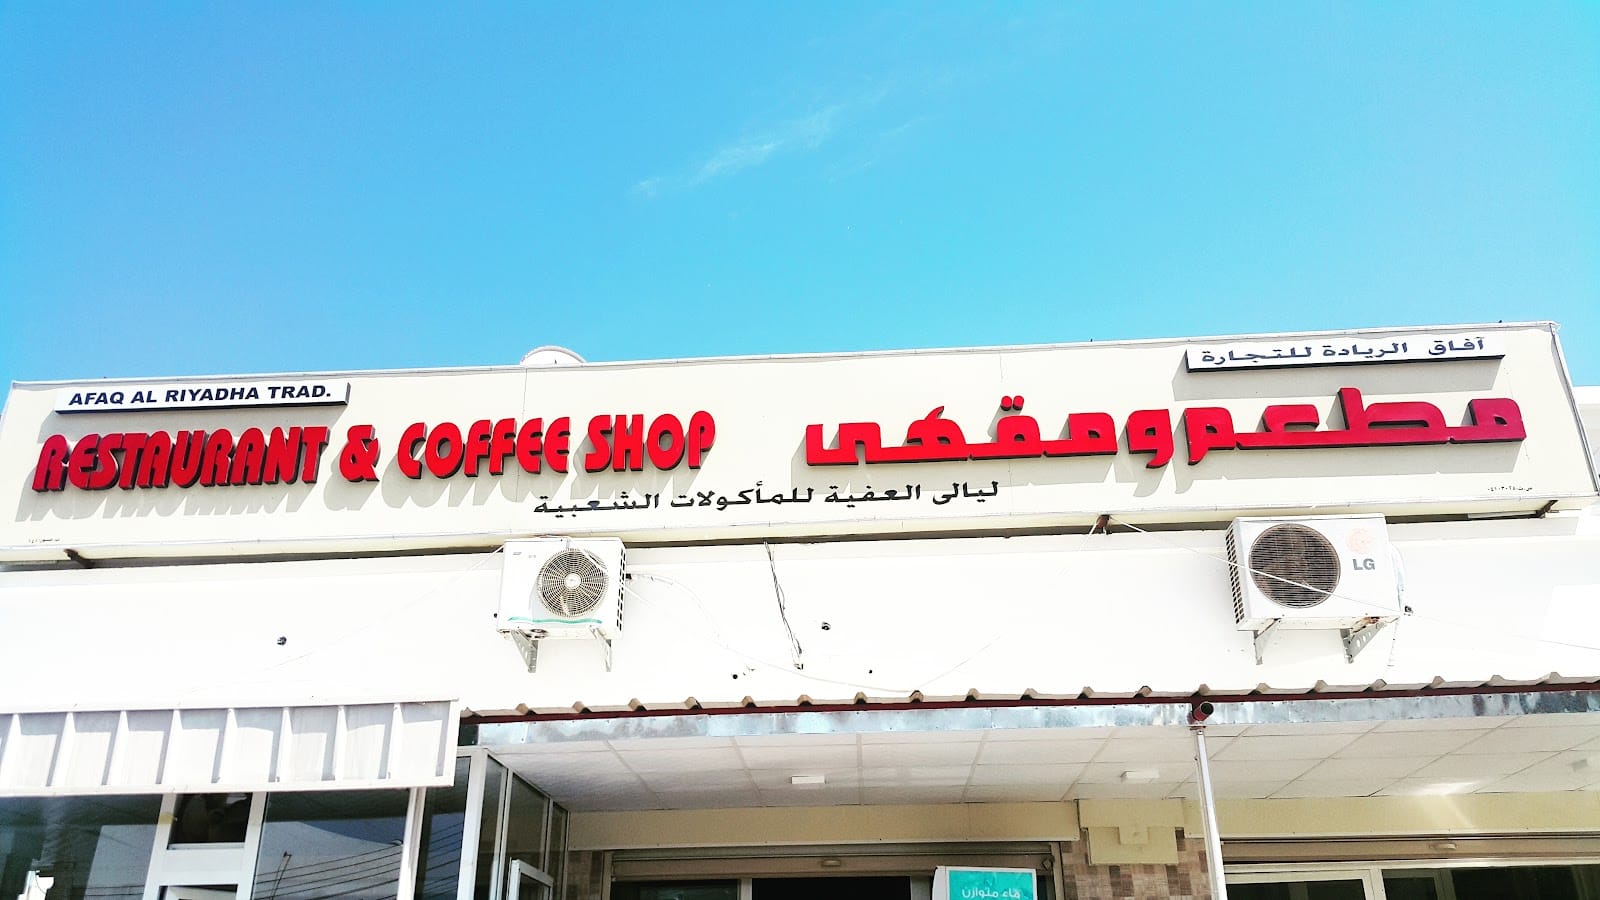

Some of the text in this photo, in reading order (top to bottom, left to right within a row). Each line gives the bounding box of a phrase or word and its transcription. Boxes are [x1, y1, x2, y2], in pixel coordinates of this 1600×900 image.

[1201, 336, 1485, 366] آفاق الريادة للتجارة
[68, 385, 332, 406] AFAQ AL RIYADHA TRAD.
[1183, 387, 1527, 466] مطعم
[31, 410, 716, 492] RESTAURANT & COFFEE SHOP
[533, 491, 660, 518] الشعبية
[670, 480, 815, 511] للمأكولات
[824, 484, 921, 508] العفية
[1352, 558, 1376, 571] LG
